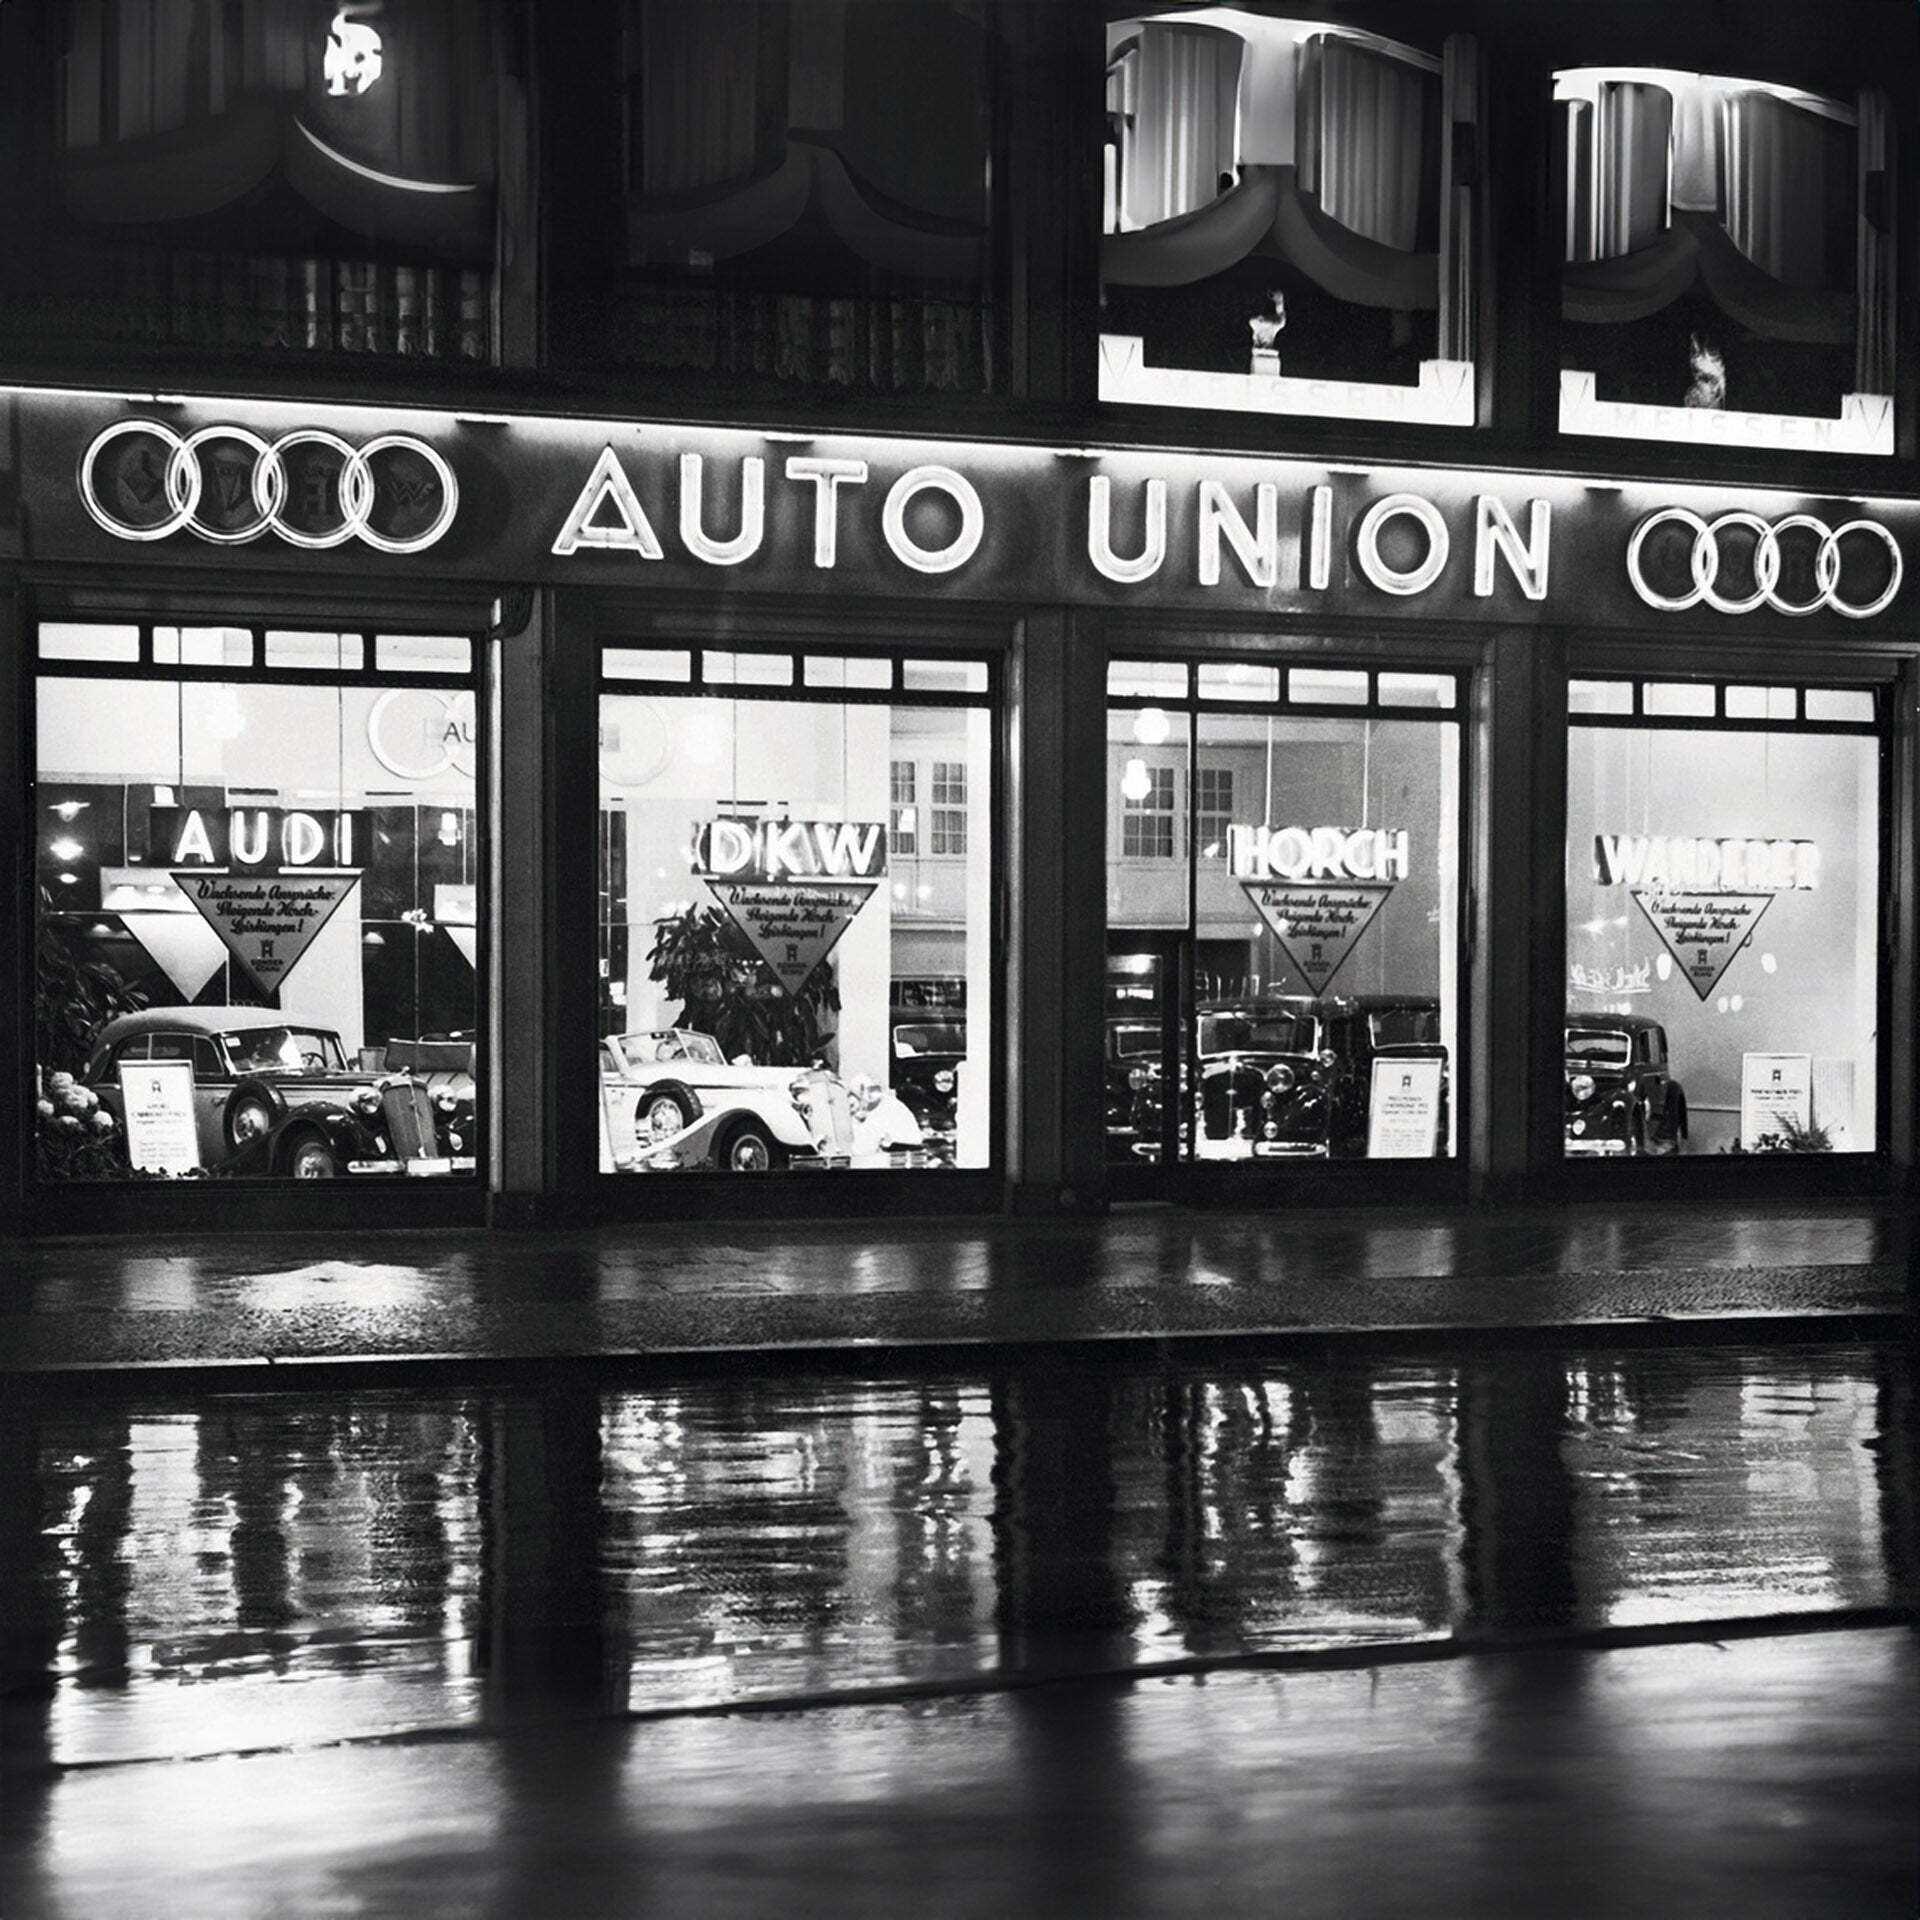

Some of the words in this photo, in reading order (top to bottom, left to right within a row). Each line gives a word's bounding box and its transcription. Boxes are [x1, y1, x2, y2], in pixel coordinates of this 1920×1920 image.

[551, 444, 984, 574] AUTO
[1087, 475, 1552, 600] UNION
[173, 809, 352, 865] AUDI
[697, 820, 881, 875] DKW
[1227, 824, 1408, 880] HORCH
